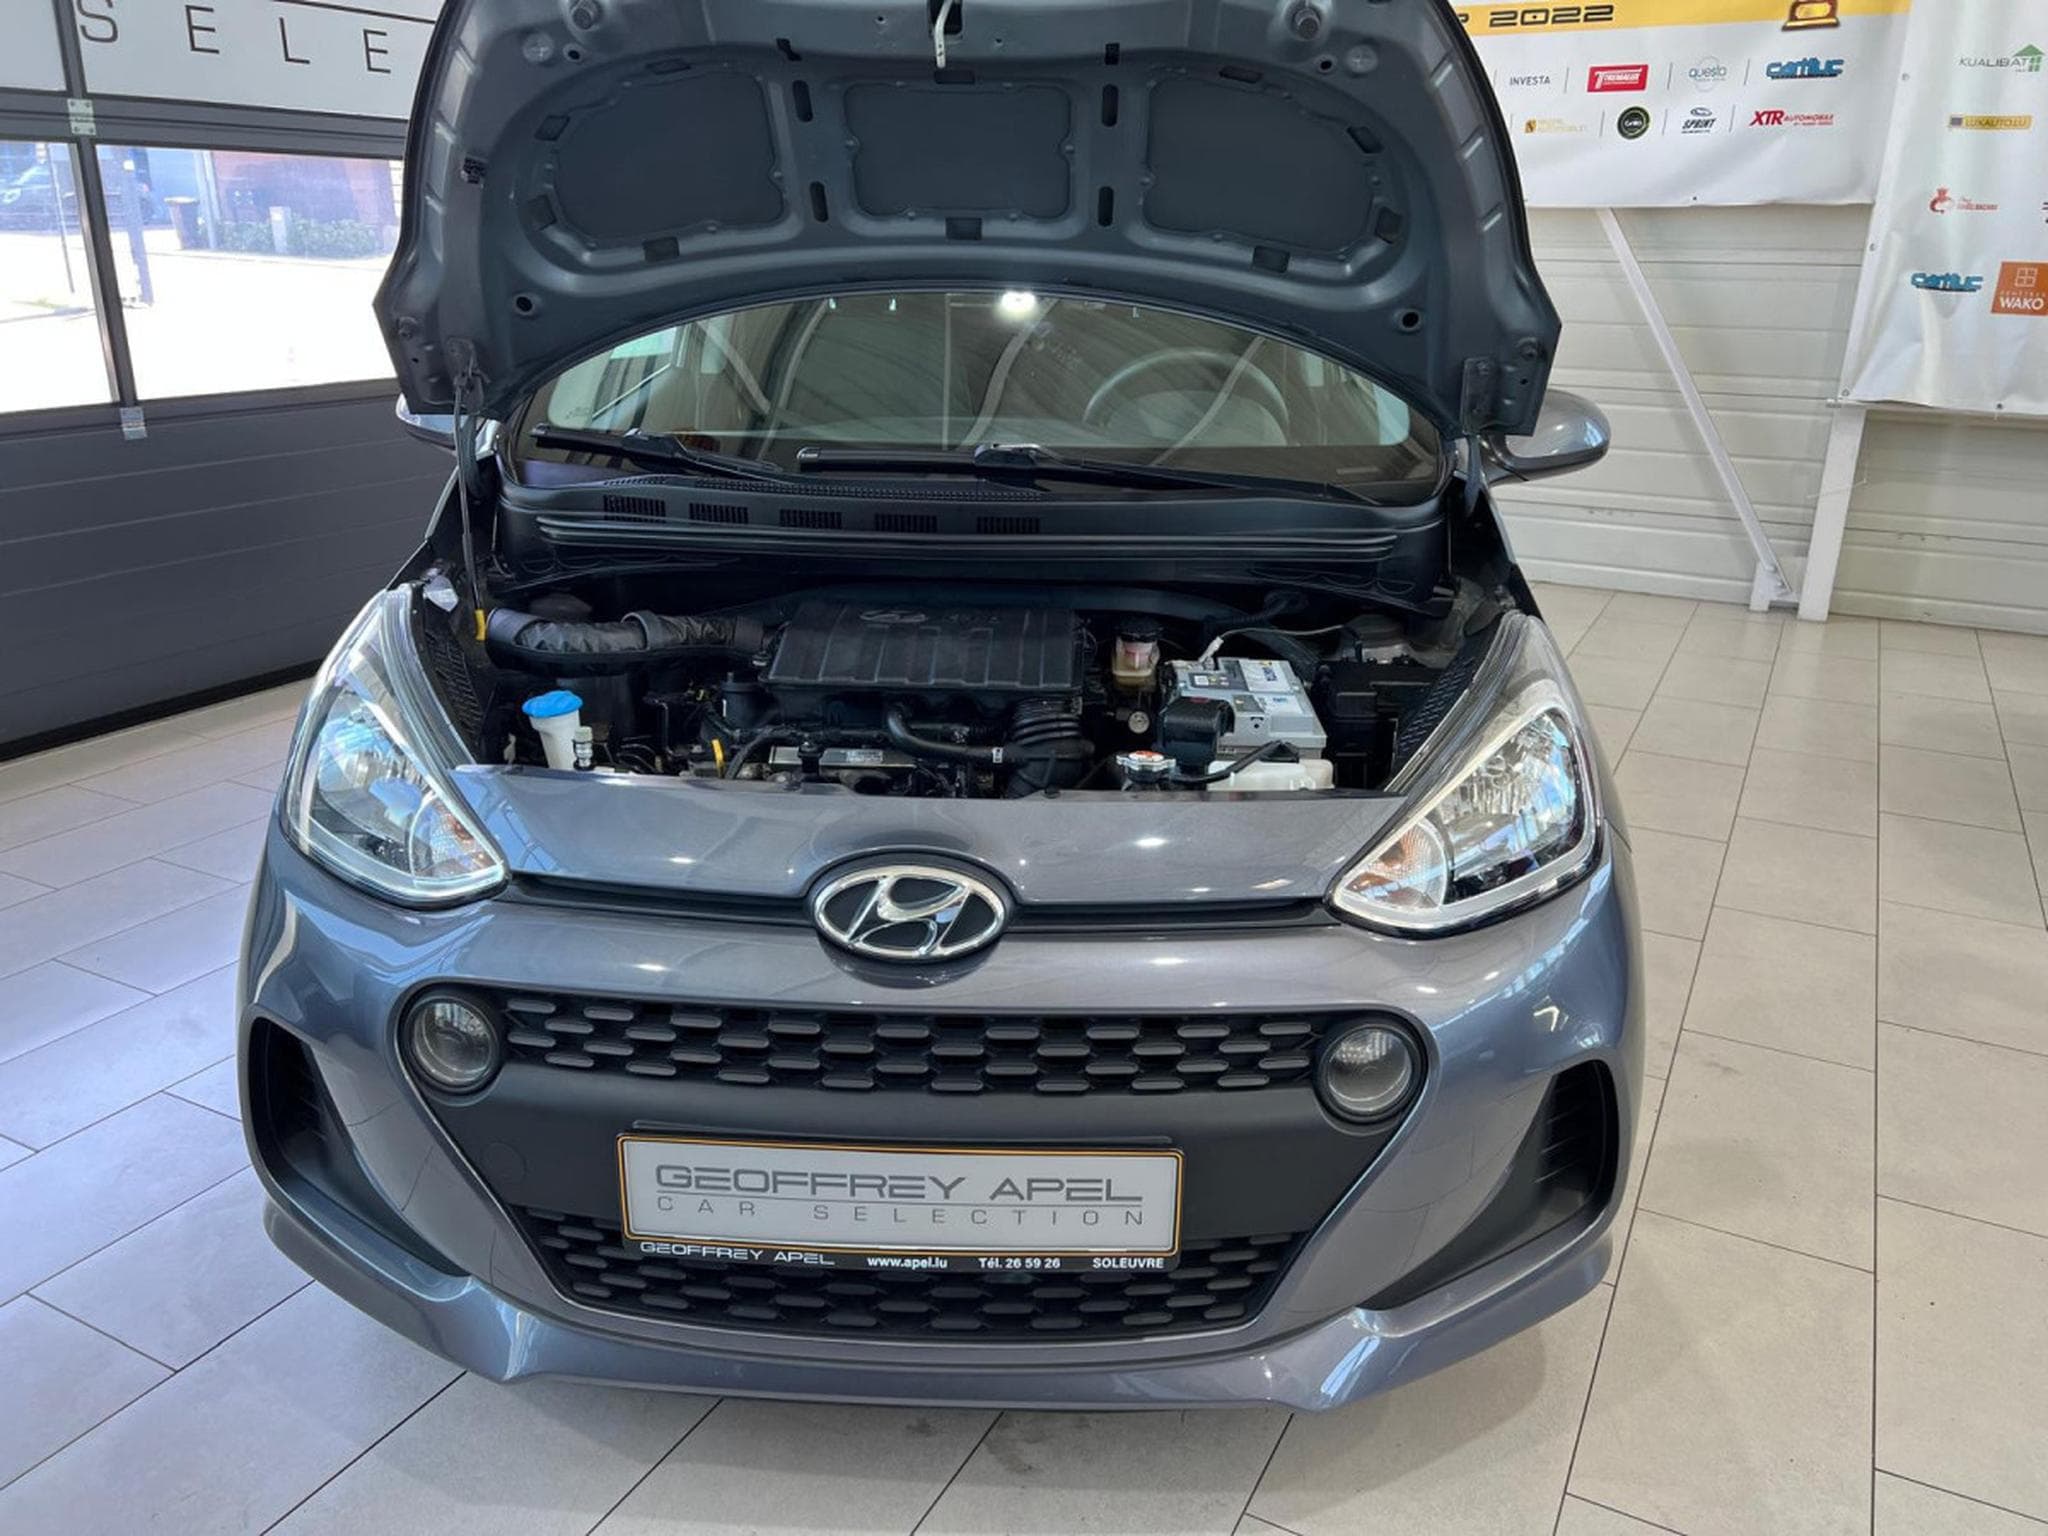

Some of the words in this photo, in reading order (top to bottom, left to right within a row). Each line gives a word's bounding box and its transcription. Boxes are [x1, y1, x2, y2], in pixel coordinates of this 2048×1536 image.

[1489, 5, 1615, 28] 2022
[1510, 75, 1550, 86] INVESTA
[1750, 110, 1785, 127] XTR
[1999, 296, 2045, 312] WAKO
[656, 1164, 966, 1200] GEOFFREY
[989, 1177, 1143, 1202] APEL
[657, 1195, 756, 1217] CAR
[813, 1203, 1143, 1226] SELECTION
[640, 1241, 764, 1261] GEOFFREY
[773, 1251, 836, 1266] APEL
[867, 1257, 948, 1270] www.apel.lu
[1005, 1256, 1022, 1269] 26
[1025, 1256, 1041, 1269] 59
[1044, 1256, 1061, 1269] 26
[1092, 1257, 1165, 1270] SOLEUVRE
